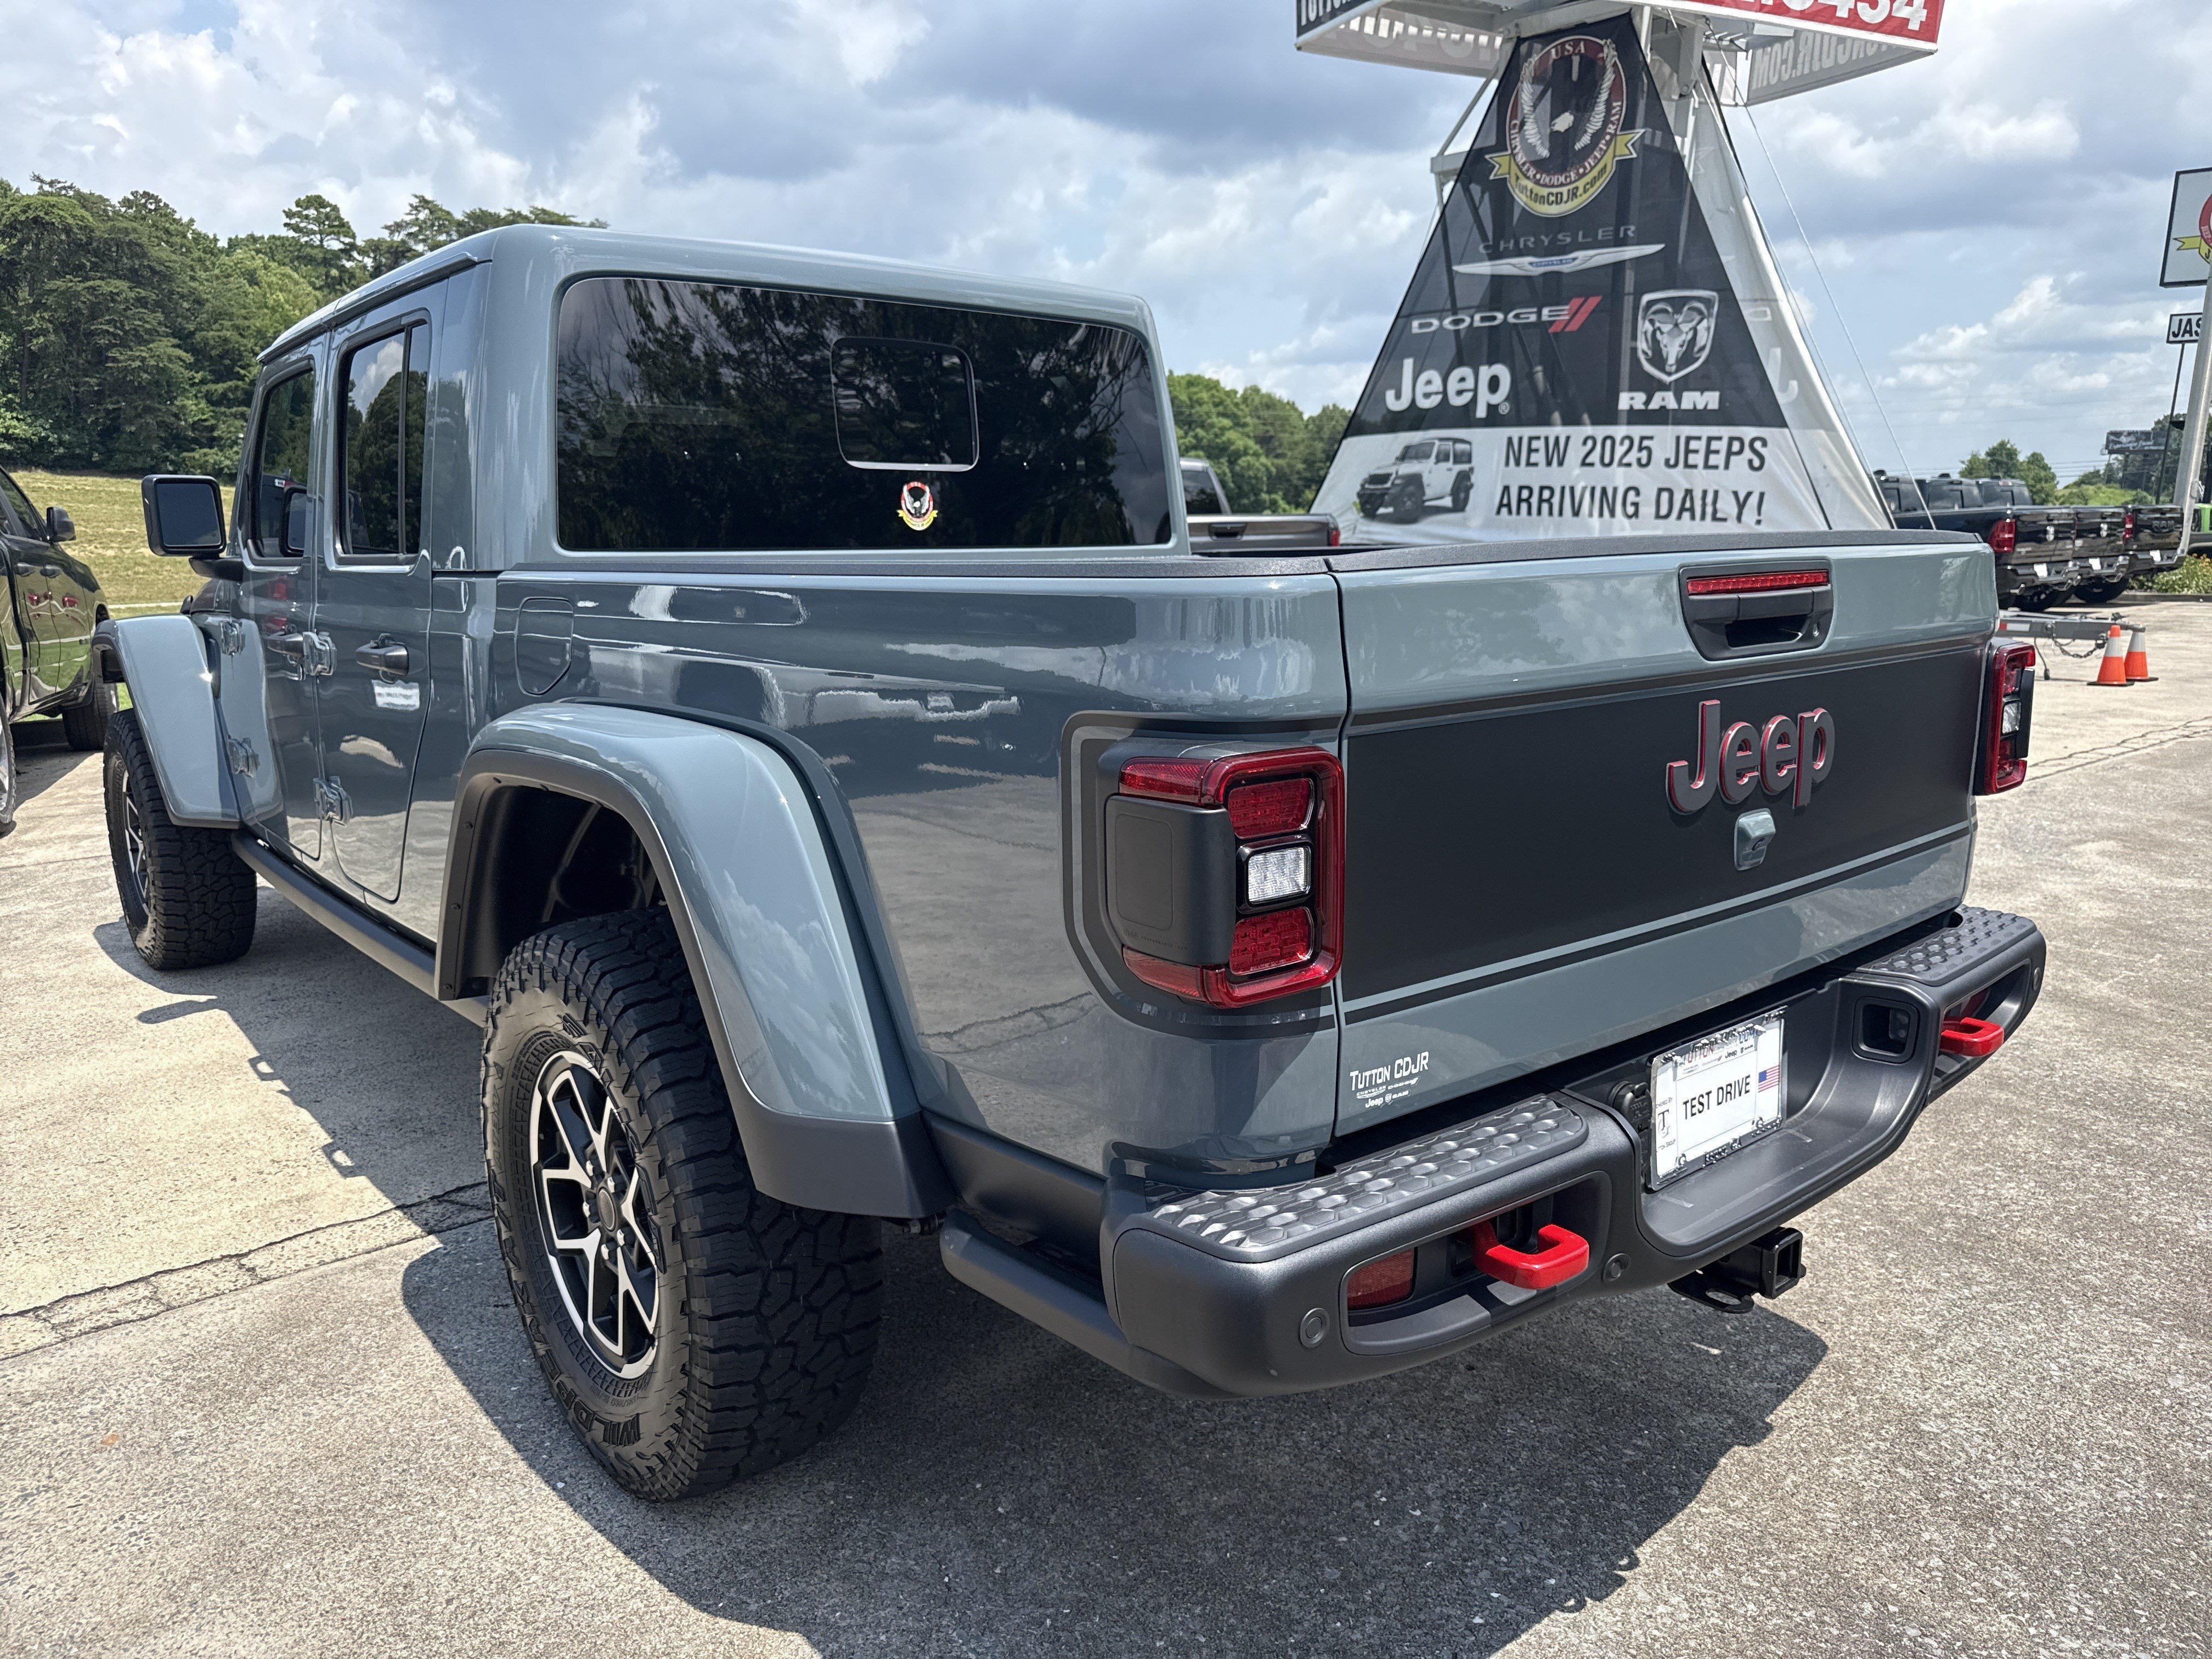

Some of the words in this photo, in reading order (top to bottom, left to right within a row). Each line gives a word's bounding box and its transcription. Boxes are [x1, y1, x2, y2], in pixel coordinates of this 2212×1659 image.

[1551, 41, 1585, 60] USA
[1510, 120, 1537, 179] CHRYSLER
[1540, 167, 1578, 186] DODGE
[1583, 140, 1607, 173] JEEP
[1606, 101, 1622, 134] RAM
[1479, 224, 1636, 254] CHRYSLER
[1411, 305, 1571, 334] DODGE
[1385, 358, 1511, 418] Jeep
[1617, 391, 1720, 410] RAM
[1504, 436, 1571, 469] NEW
[1579, 436, 1654, 469] 2025
[1664, 436, 1768, 472] JEEPS
[1496, 485, 1641, 521] ARRIVING
[1654, 487, 1765, 526] DAILY!
[1666, 699, 1836, 815] Jeep
[1350, 1065, 1391, 1090] TUTTON
[1394, 1051, 1429, 1079] CDJR
[1357, 1085, 1386, 1096] CHRYSLER
[1365, 1097, 1384, 1108] Jeep
[1392, 1090, 1409, 1099] RAM
[1683, 1090, 1712, 1120] TEST
[1717, 1074, 1751, 1107] DRIVE
